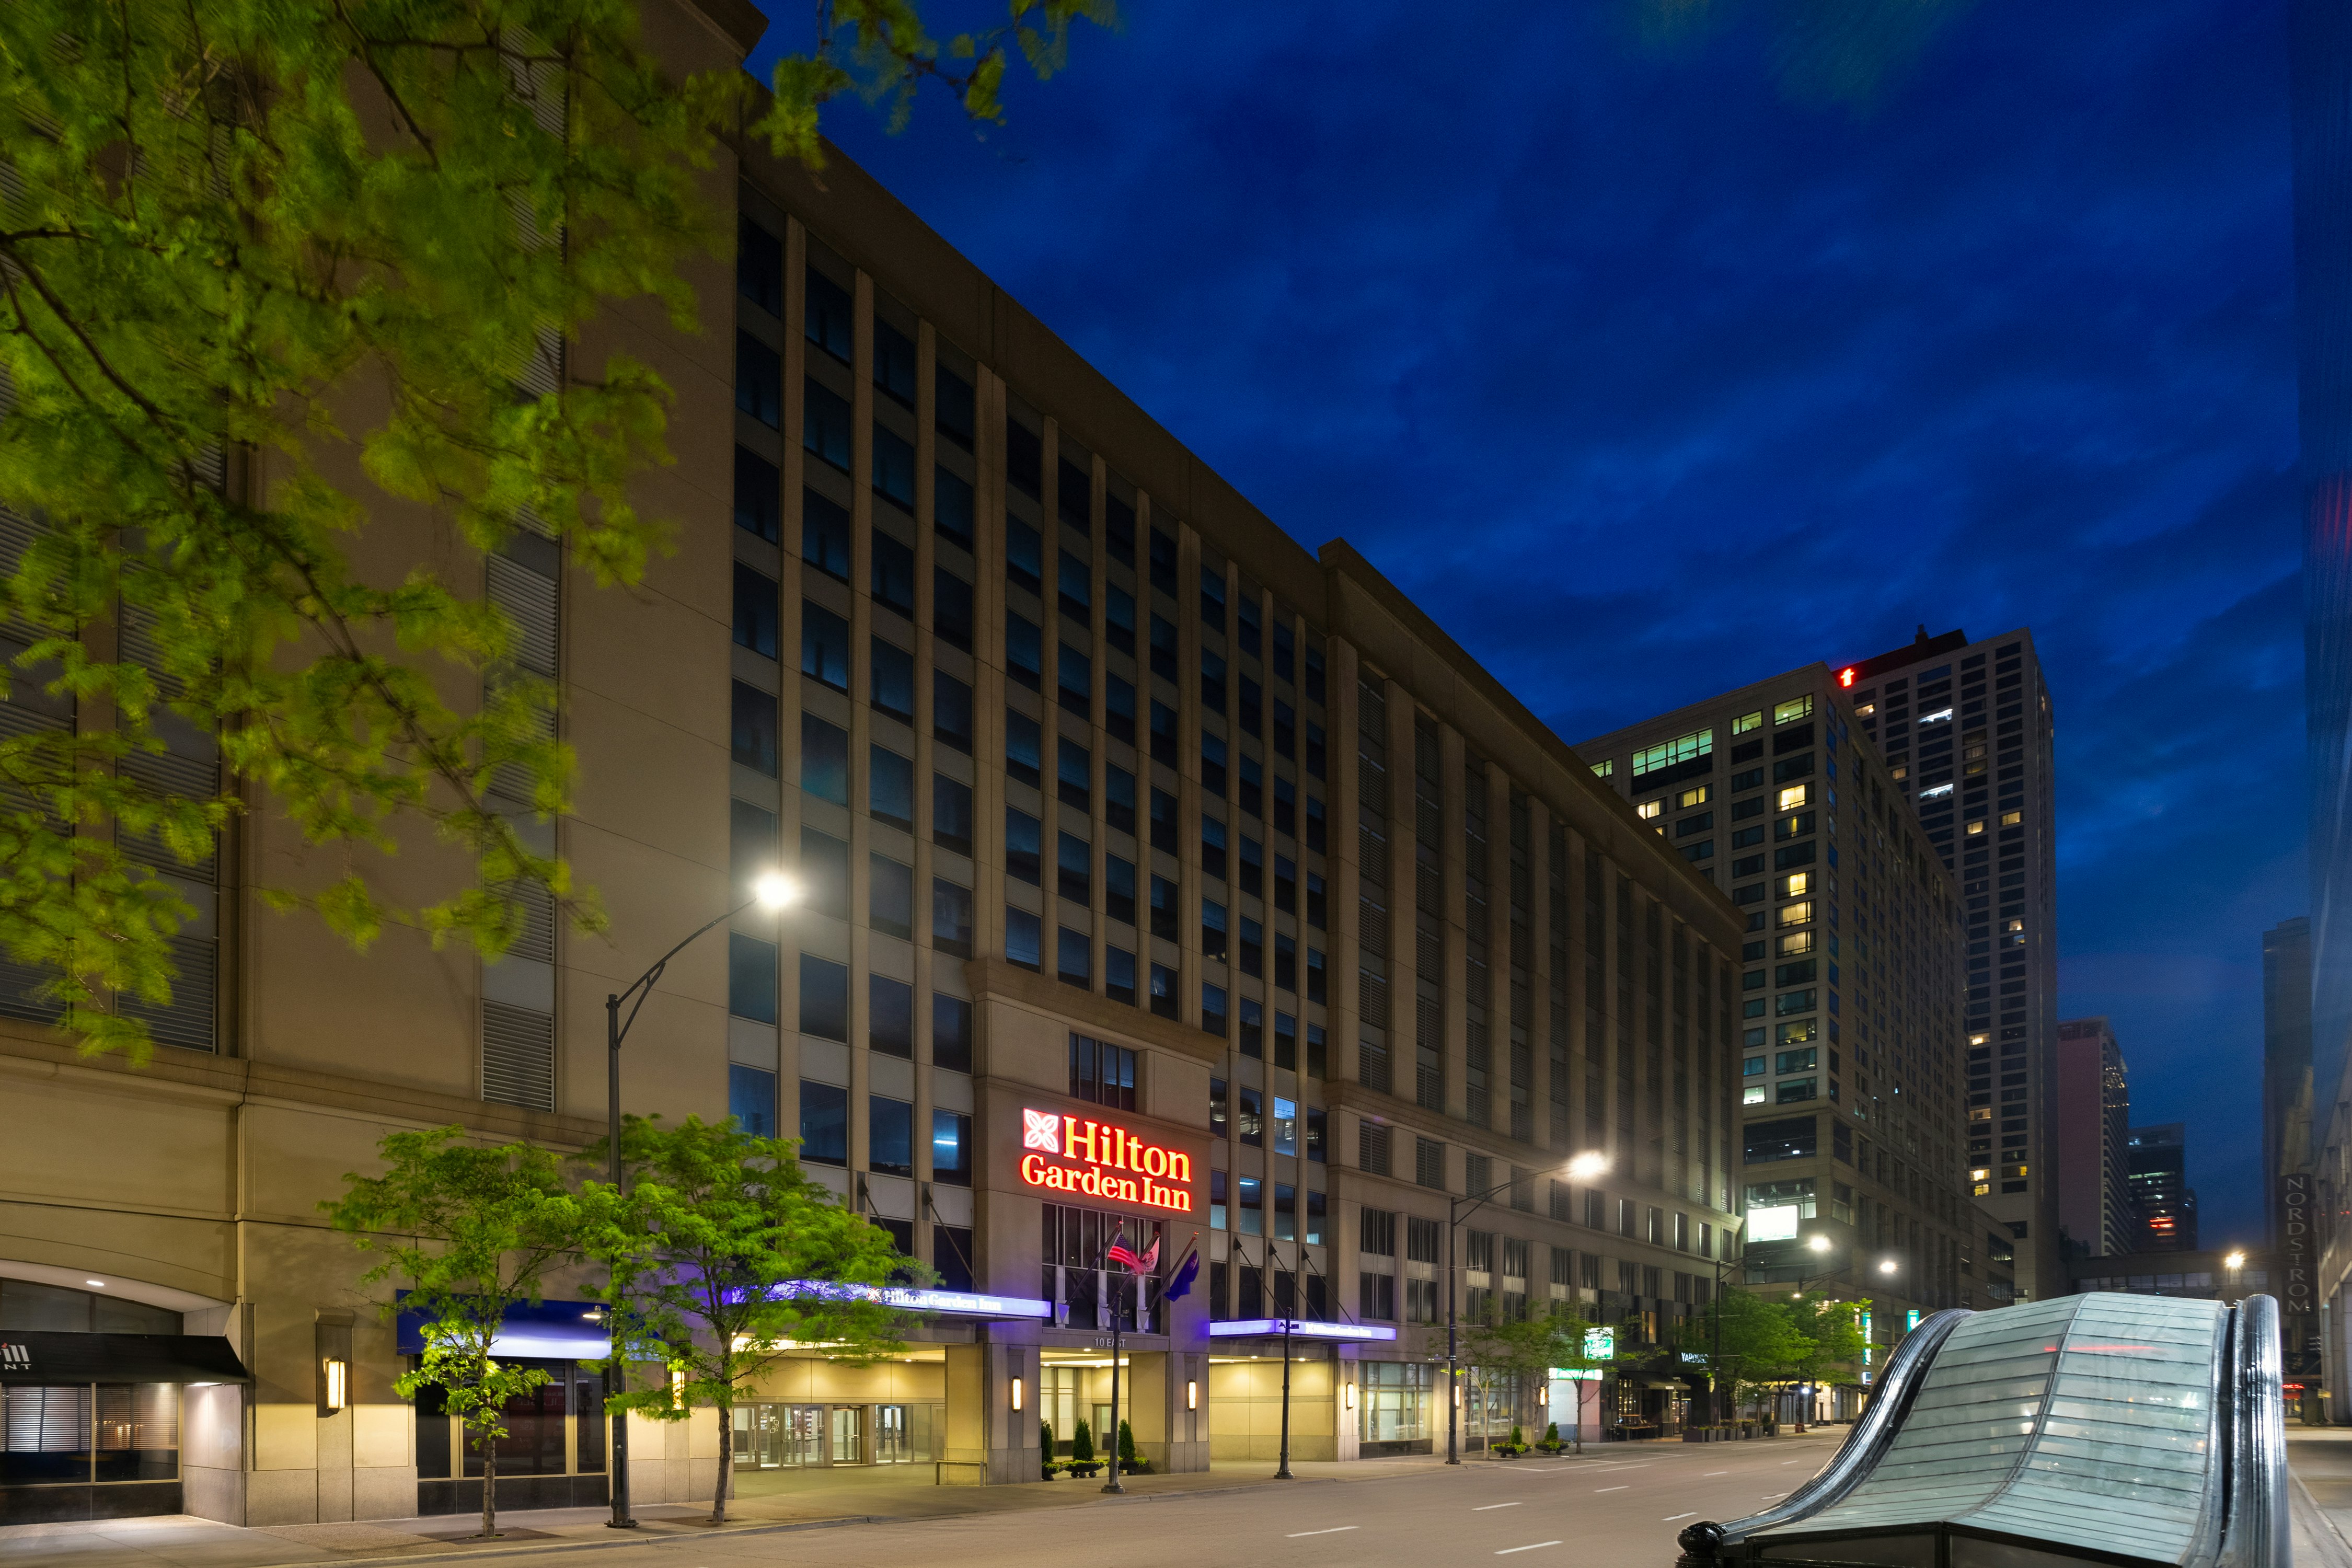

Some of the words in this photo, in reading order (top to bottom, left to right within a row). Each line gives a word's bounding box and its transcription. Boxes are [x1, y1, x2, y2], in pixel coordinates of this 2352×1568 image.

[1063, 1115, 1191, 1182] Hilton
[1021, 1154, 1139, 1202] Garden
[1142, 1177, 1192, 1212] Inn
[2285, 1177, 2311, 1312] NORDSTROM
[884, 1289, 928, 1306] Hilton
[928, 1294, 977, 1309] Garden
[978, 1298, 1002, 1311] Inn
[0, 1342, 30, 1362] ill
[1095, 1338, 1104, 1347] 10
